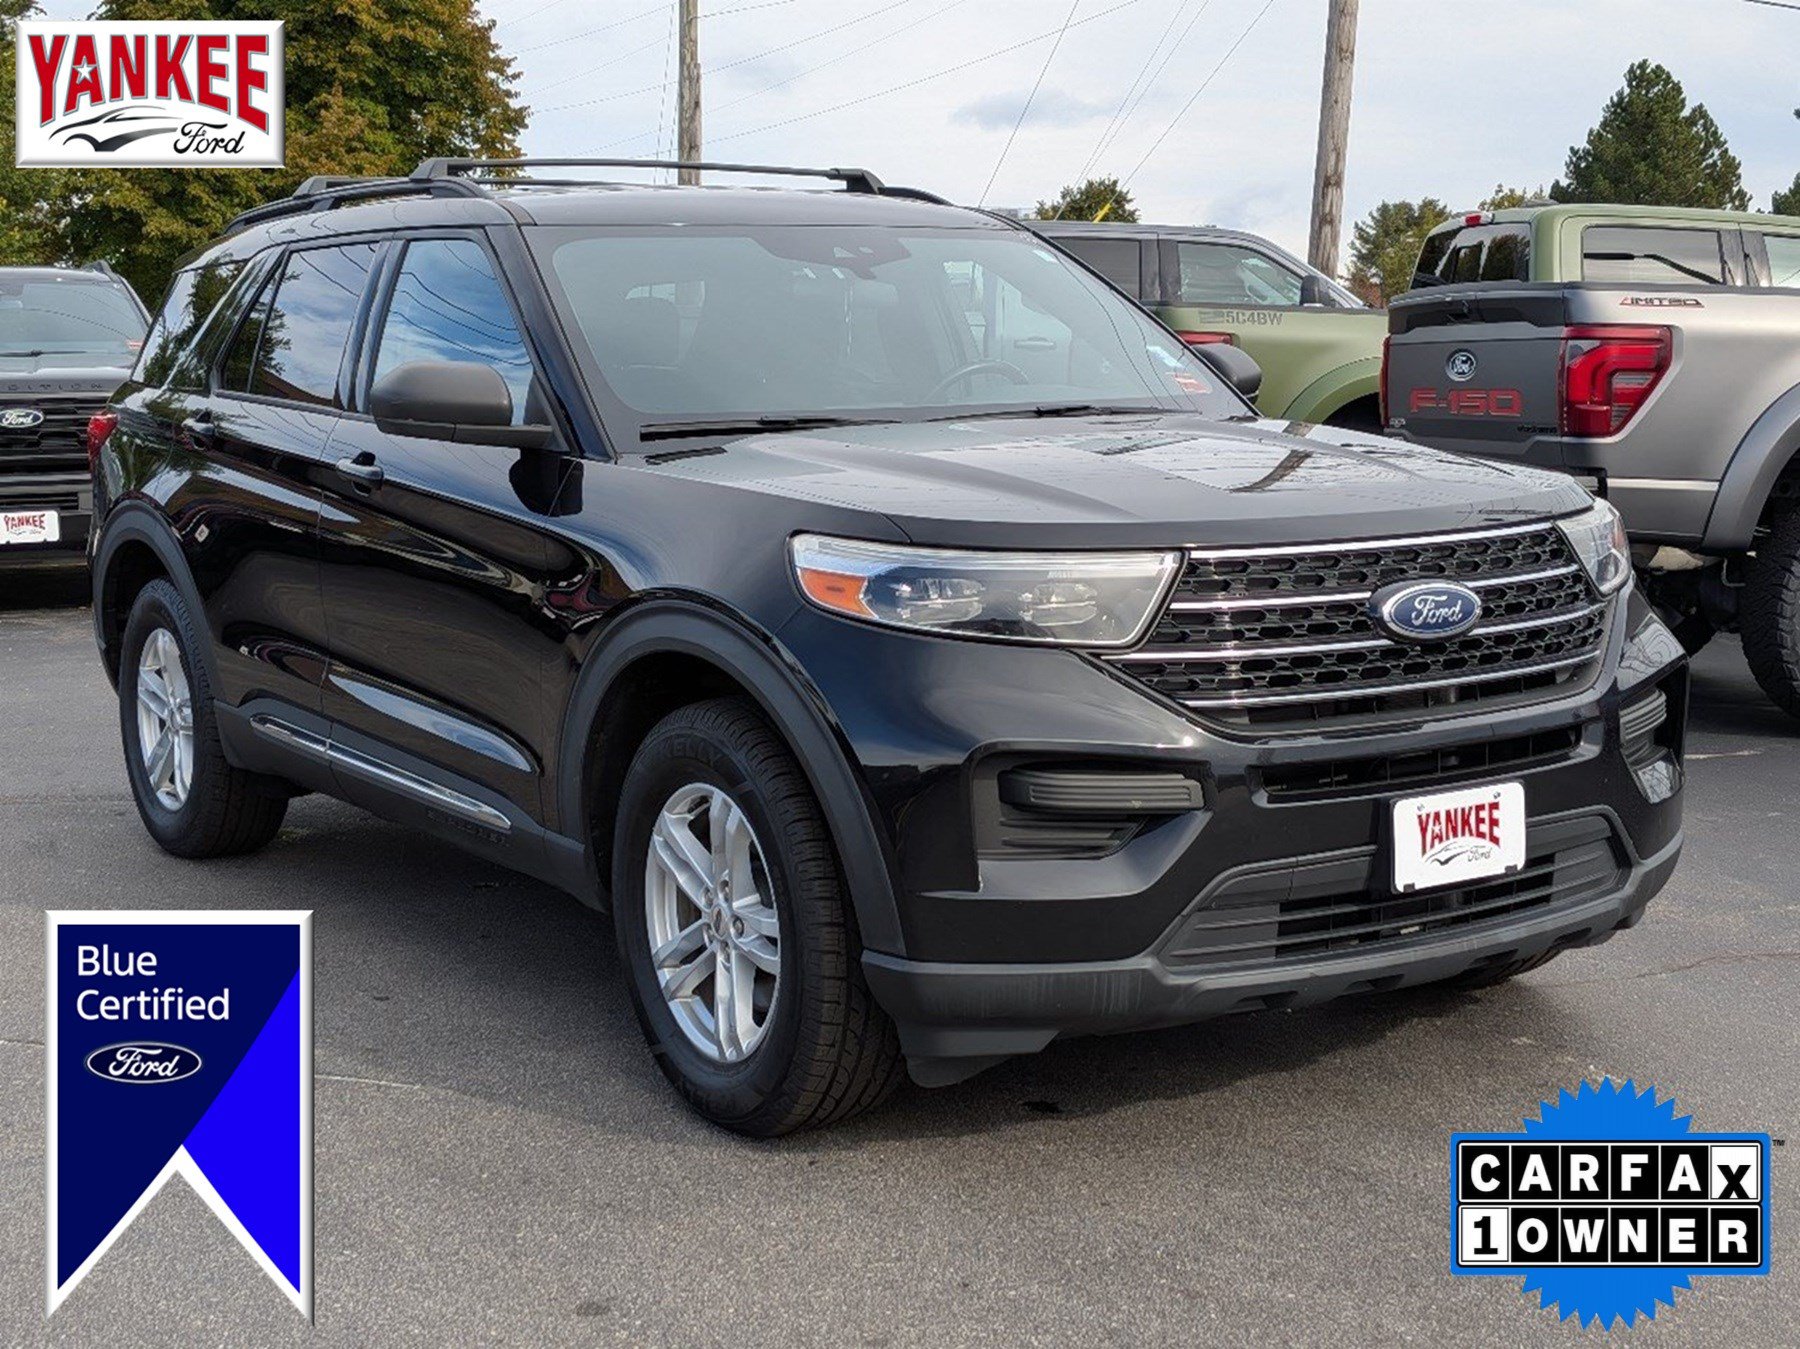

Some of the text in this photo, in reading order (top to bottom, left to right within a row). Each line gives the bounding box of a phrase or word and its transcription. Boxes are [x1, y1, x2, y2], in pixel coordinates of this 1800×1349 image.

[1409, 388, 1523, 417] F-150
[2, 410, 34, 425] Ford
[3, 513, 46, 532] YANKEE
[1411, 594, 1463, 626] Ford
[1416, 800, 1501, 858] YANKEE
